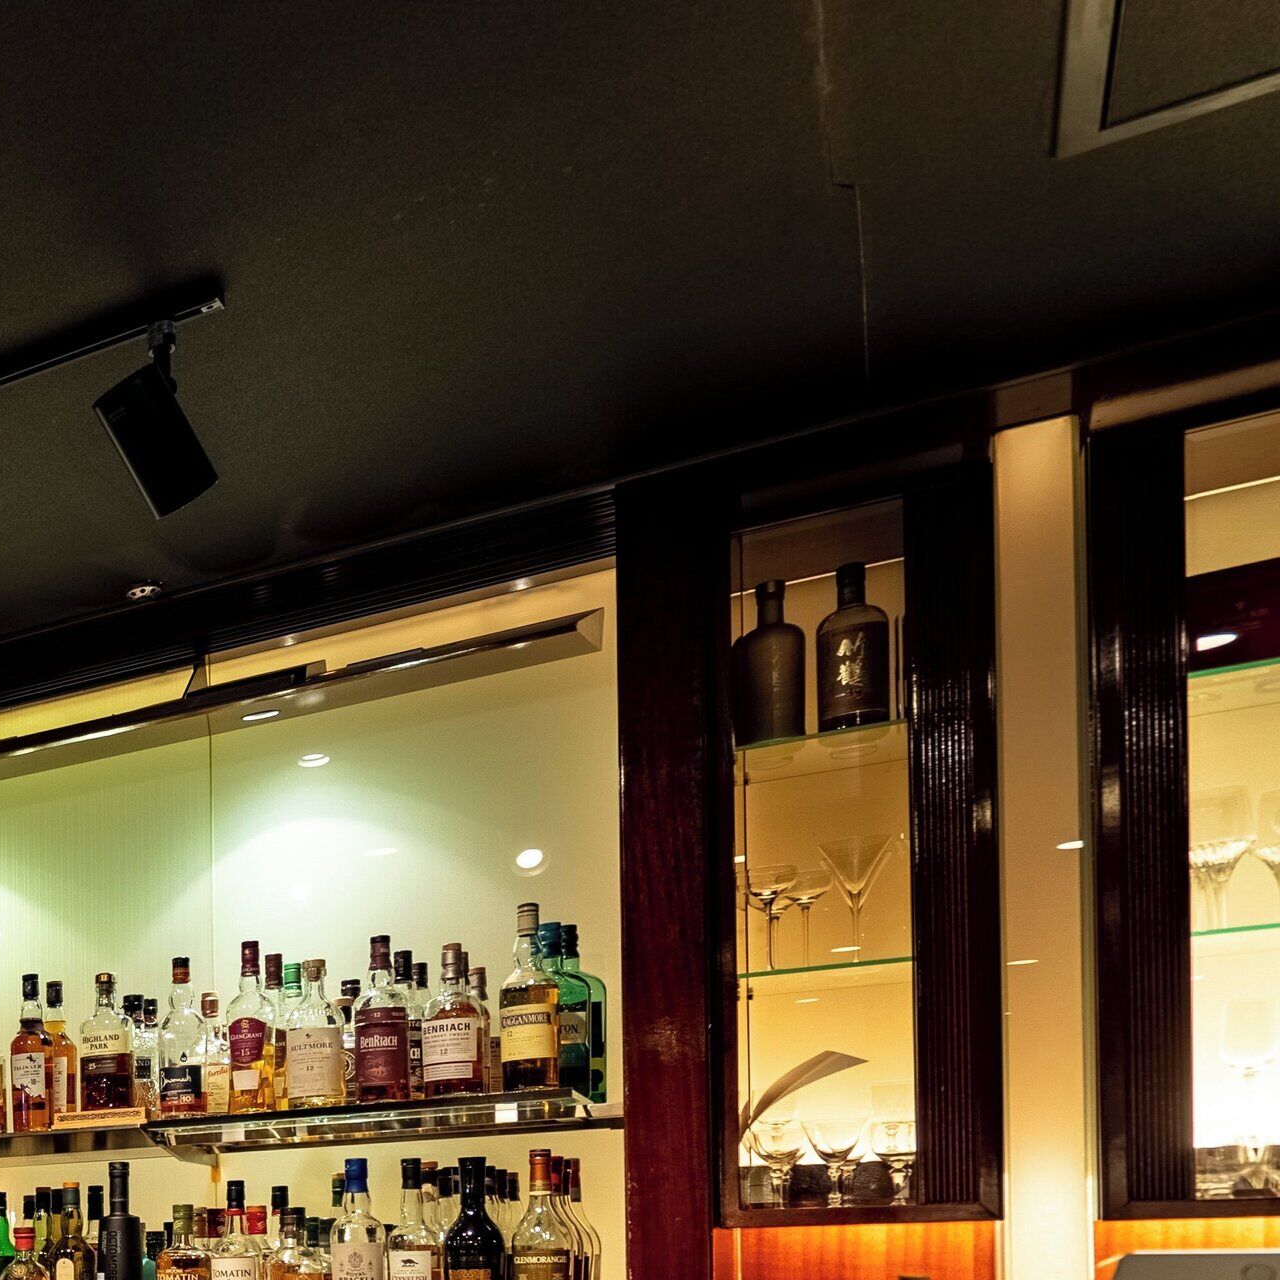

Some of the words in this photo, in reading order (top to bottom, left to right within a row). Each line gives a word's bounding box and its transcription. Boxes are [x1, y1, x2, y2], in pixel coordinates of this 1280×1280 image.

[423, 1022, 471, 1036] BENRIACH
[82, 1034, 120, 1044] HIGHLAND
[291, 1041, 333, 1052] AULTMORE
[240, 1048, 250, 1056] 15
[514, 1255, 568, 1264] GLENMORANGIE
[213, 1269, 251, 1278] TOMATIN
